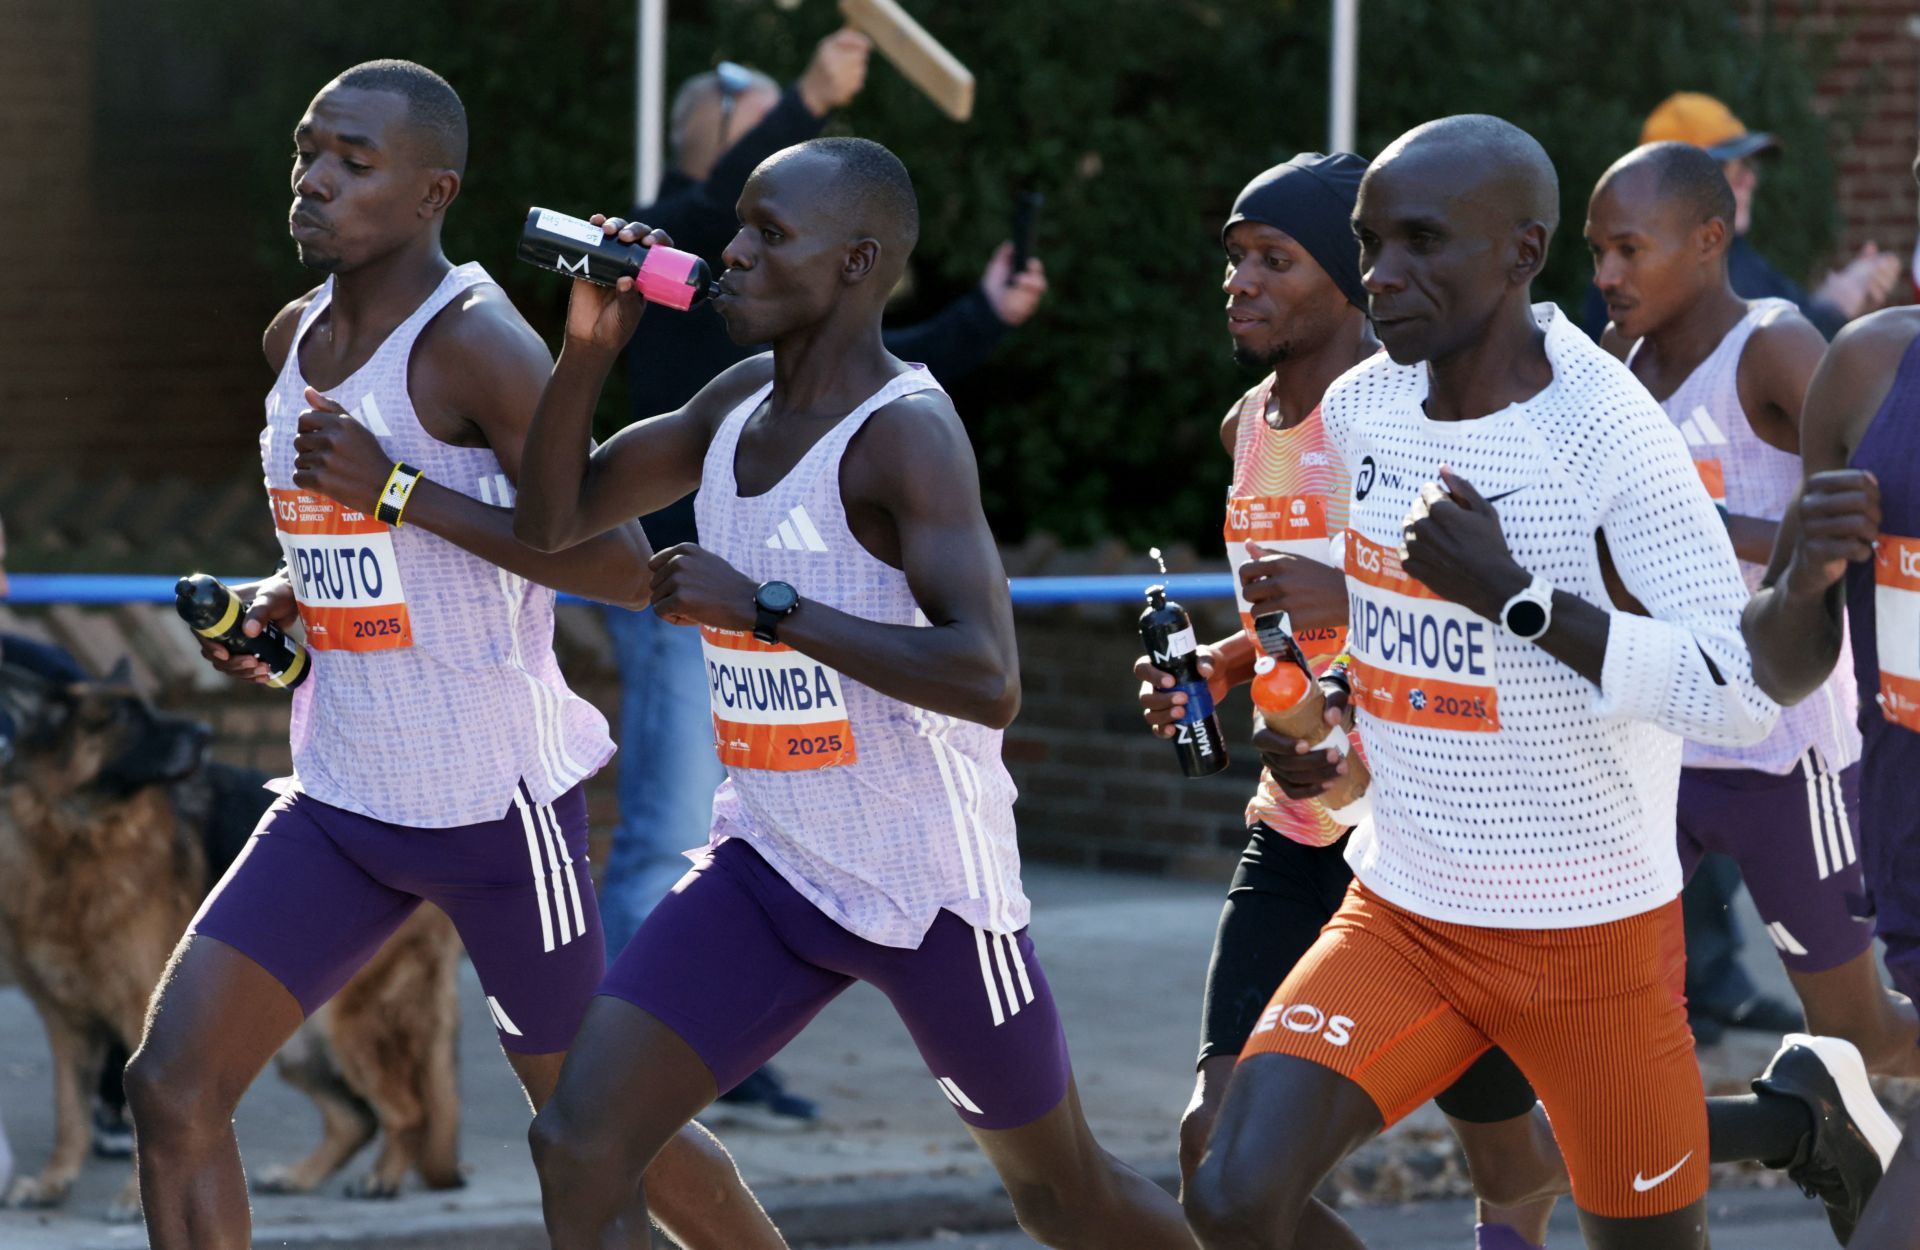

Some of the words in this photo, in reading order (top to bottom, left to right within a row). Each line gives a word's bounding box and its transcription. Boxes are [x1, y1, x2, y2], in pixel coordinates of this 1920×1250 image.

[1379, 472, 1402, 489] NN
[341, 512, 365, 521] TATA
[1289, 517, 1310, 527] TATA
[1355, 538, 1380, 573] tcs
[1900, 543, 1920, 579] tc
[354, 618, 401, 638] 2025
[1351, 593, 1486, 676] KIPCHOGE
[1434, 695, 1487, 718] 2025
[787, 735, 843, 756] 2025
